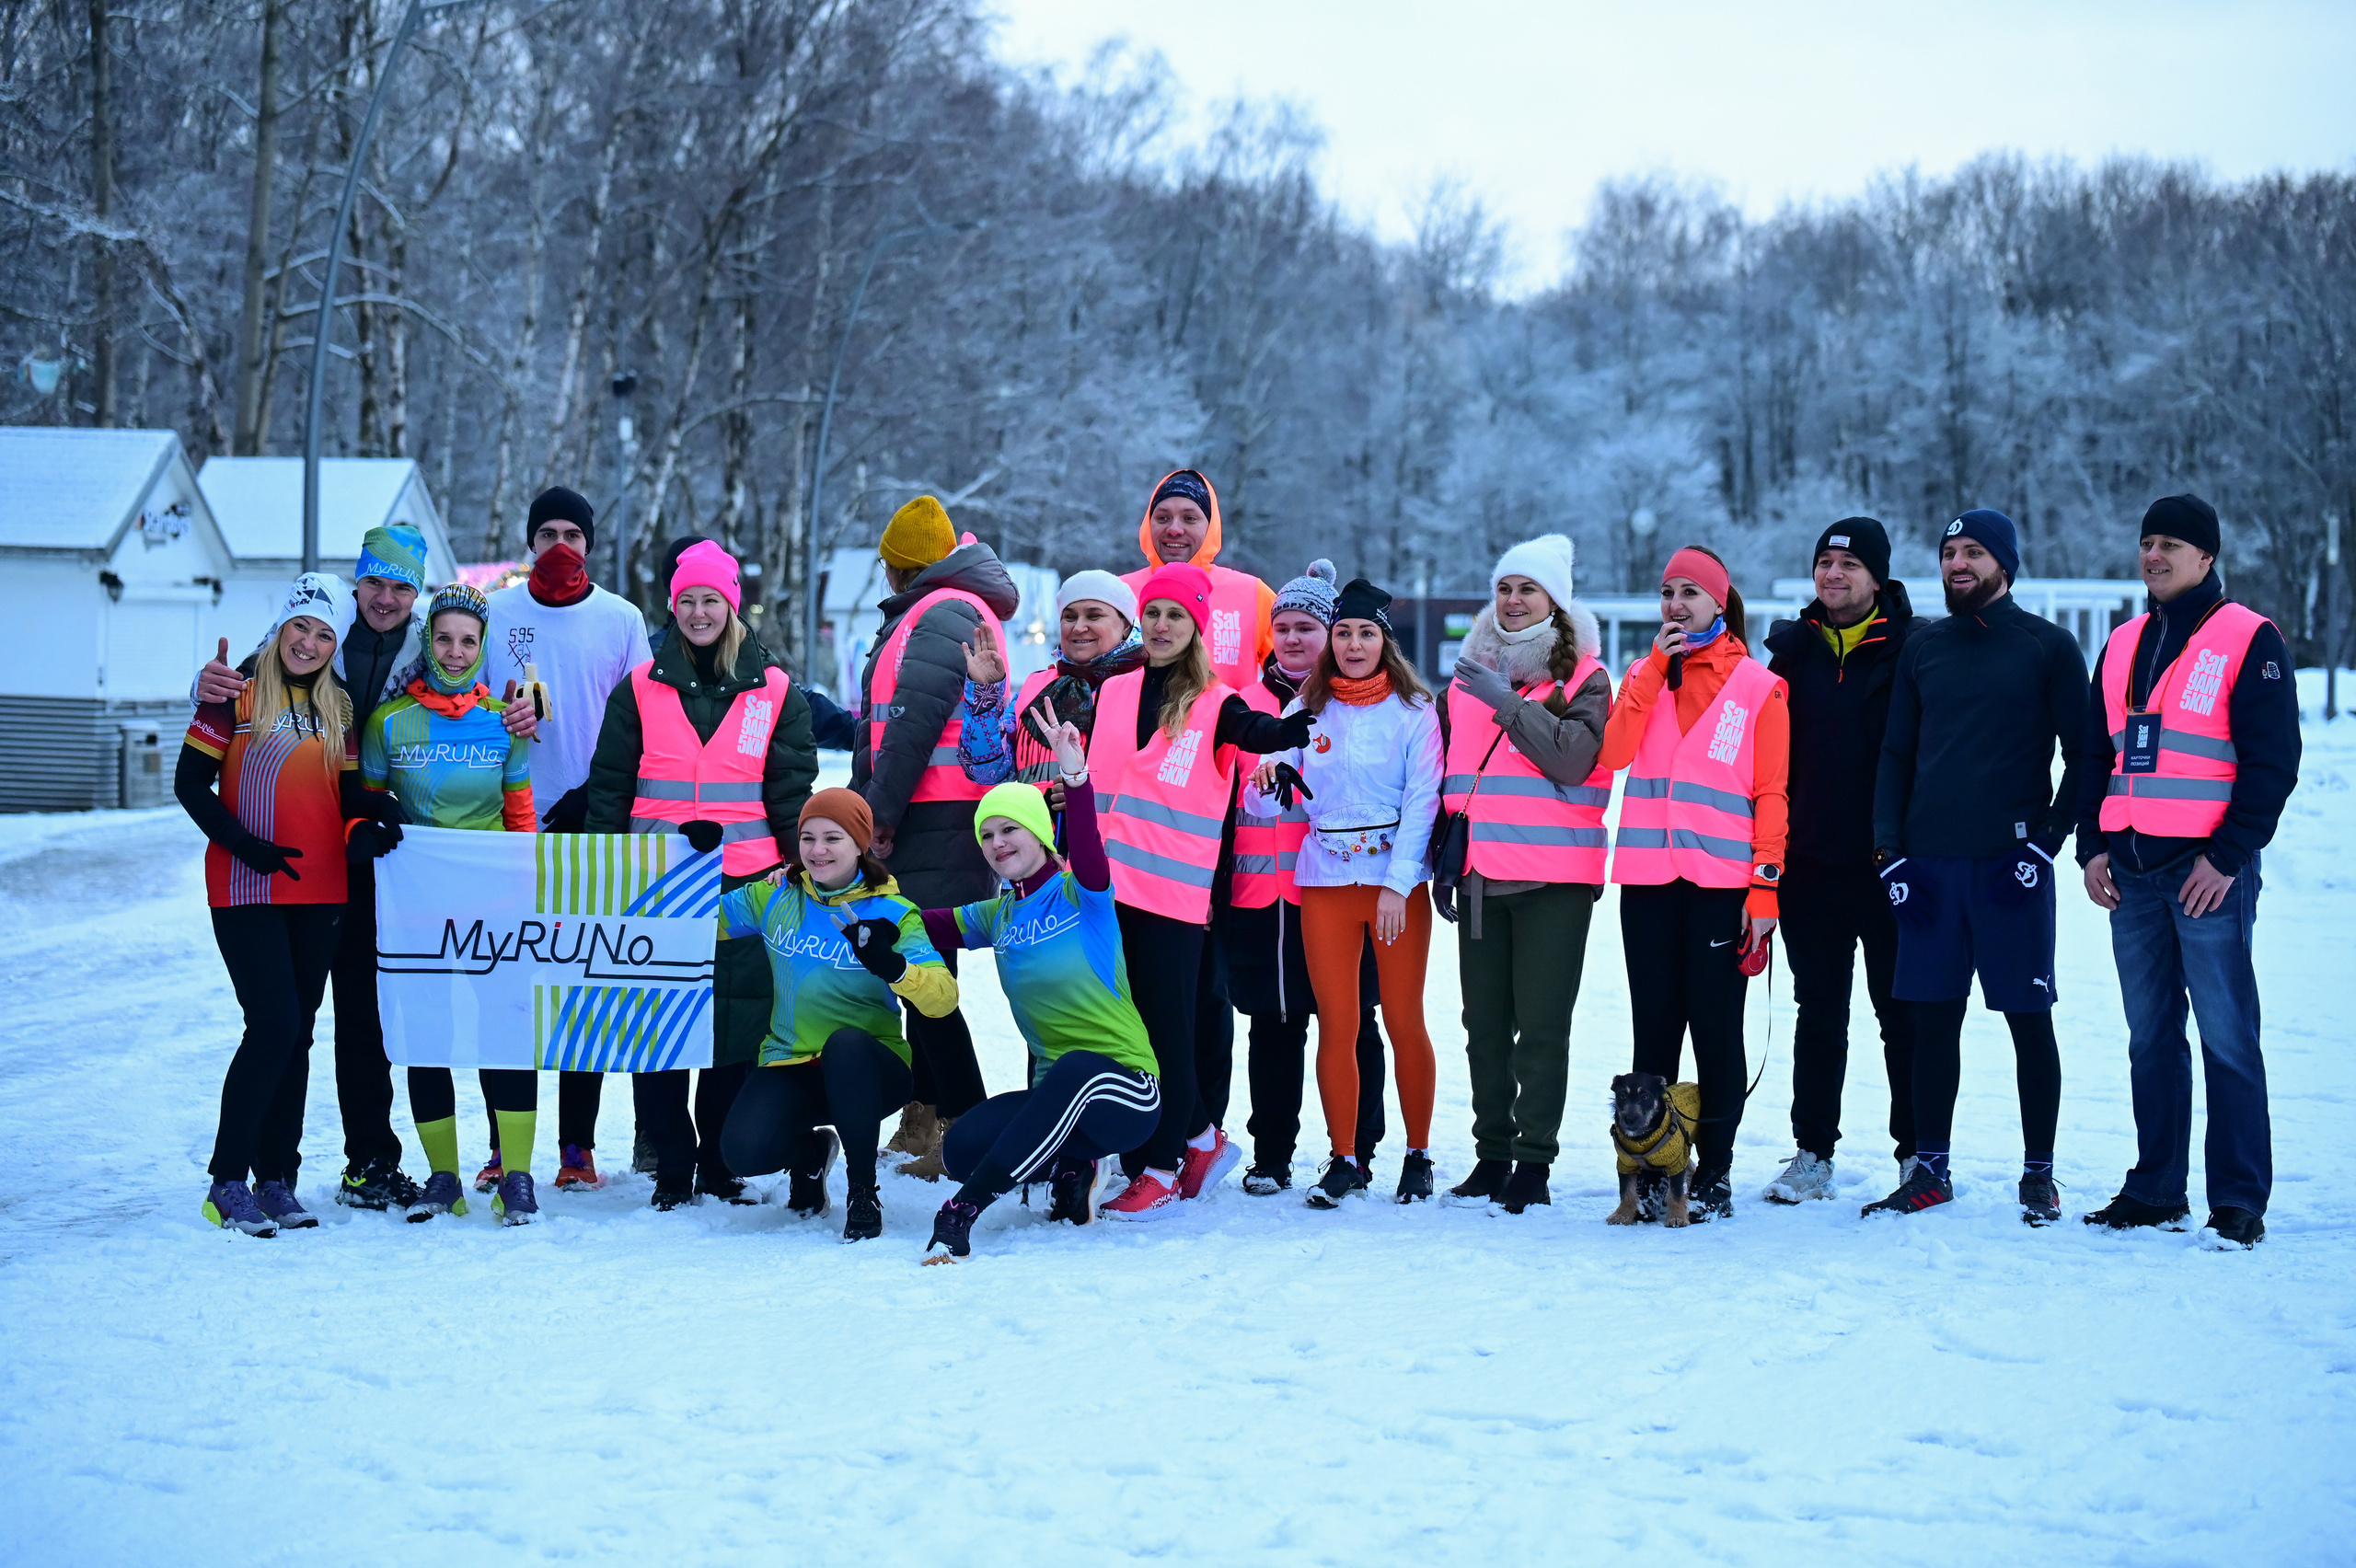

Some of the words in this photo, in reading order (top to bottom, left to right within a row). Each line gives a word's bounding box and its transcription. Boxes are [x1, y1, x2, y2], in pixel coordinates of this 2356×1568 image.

[1212, 609, 1241, 631] Sat
[1213, 630, 1241, 648] 9AM
[1213, 646, 1240, 665] 5KM
[2194, 648, 2228, 678] Sat
[2186, 671, 2223, 698] 9AM
[745, 694, 773, 722] Sat
[2179, 689, 2215, 717] 5KM
[741, 716, 770, 740] 9AM
[1714, 721, 1744, 748] 9AM
[2138, 724, 2149, 734] Sat
[737, 734, 765, 758] 5KM
[1164, 745, 1196, 769] 9AM
[1707, 740, 1738, 766] 5KM
[1157, 762, 1191, 788] 5KM
[439, 918, 654, 979] MyRUNo
[771, 923, 862, 971] MyRUN
[1150, 1193, 1172, 1208] HOKA
